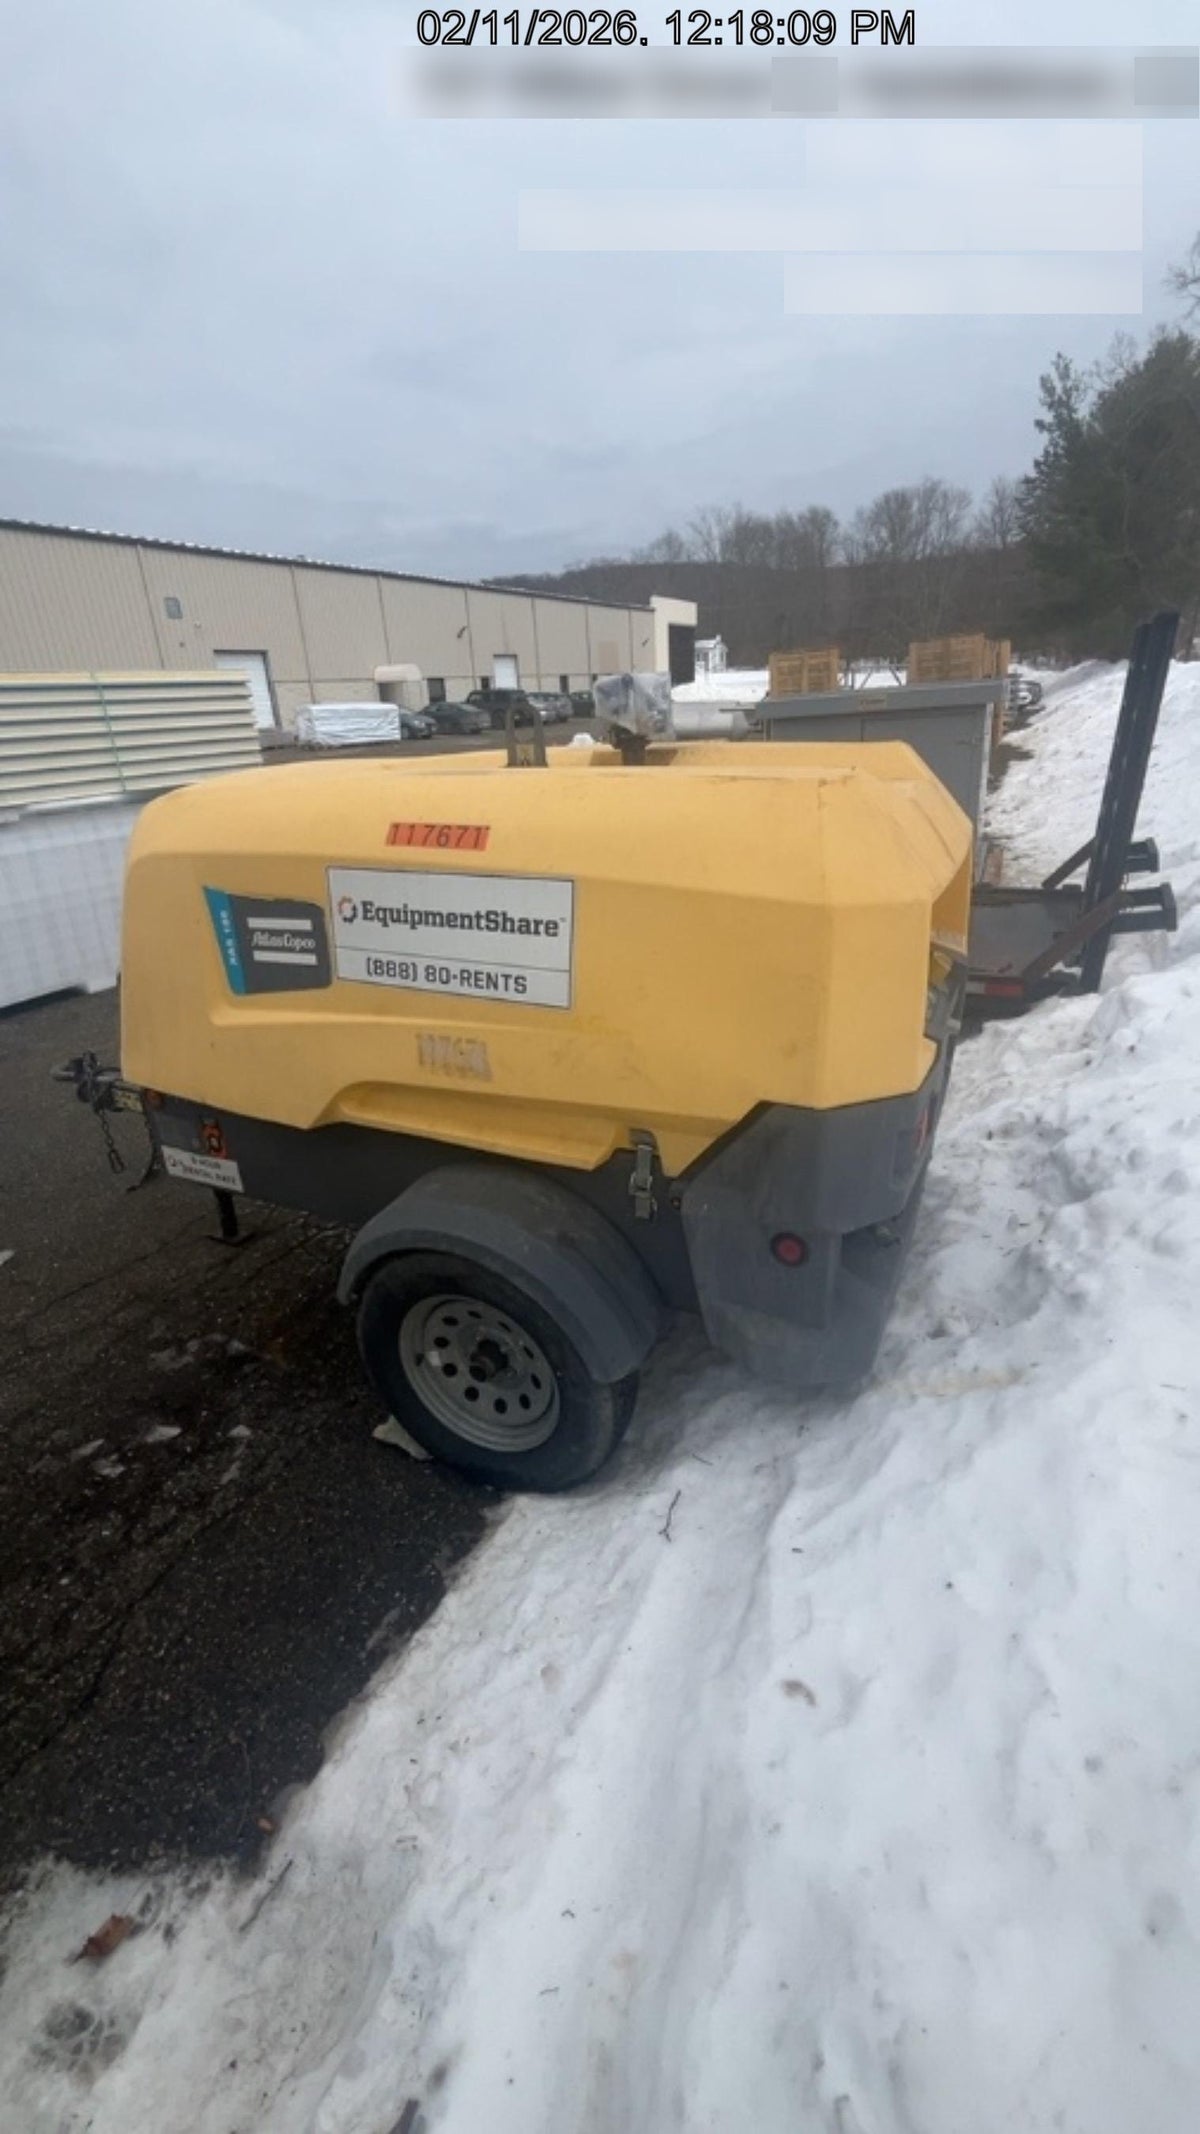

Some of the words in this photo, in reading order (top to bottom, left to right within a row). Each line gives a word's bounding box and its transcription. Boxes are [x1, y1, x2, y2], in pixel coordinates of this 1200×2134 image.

[390, 824, 484, 848] 117671
[361, 900, 560, 937] EquipmentShare
[366, 956, 418, 982] (888)
[424, 964, 527, 994] 80-RENTS
